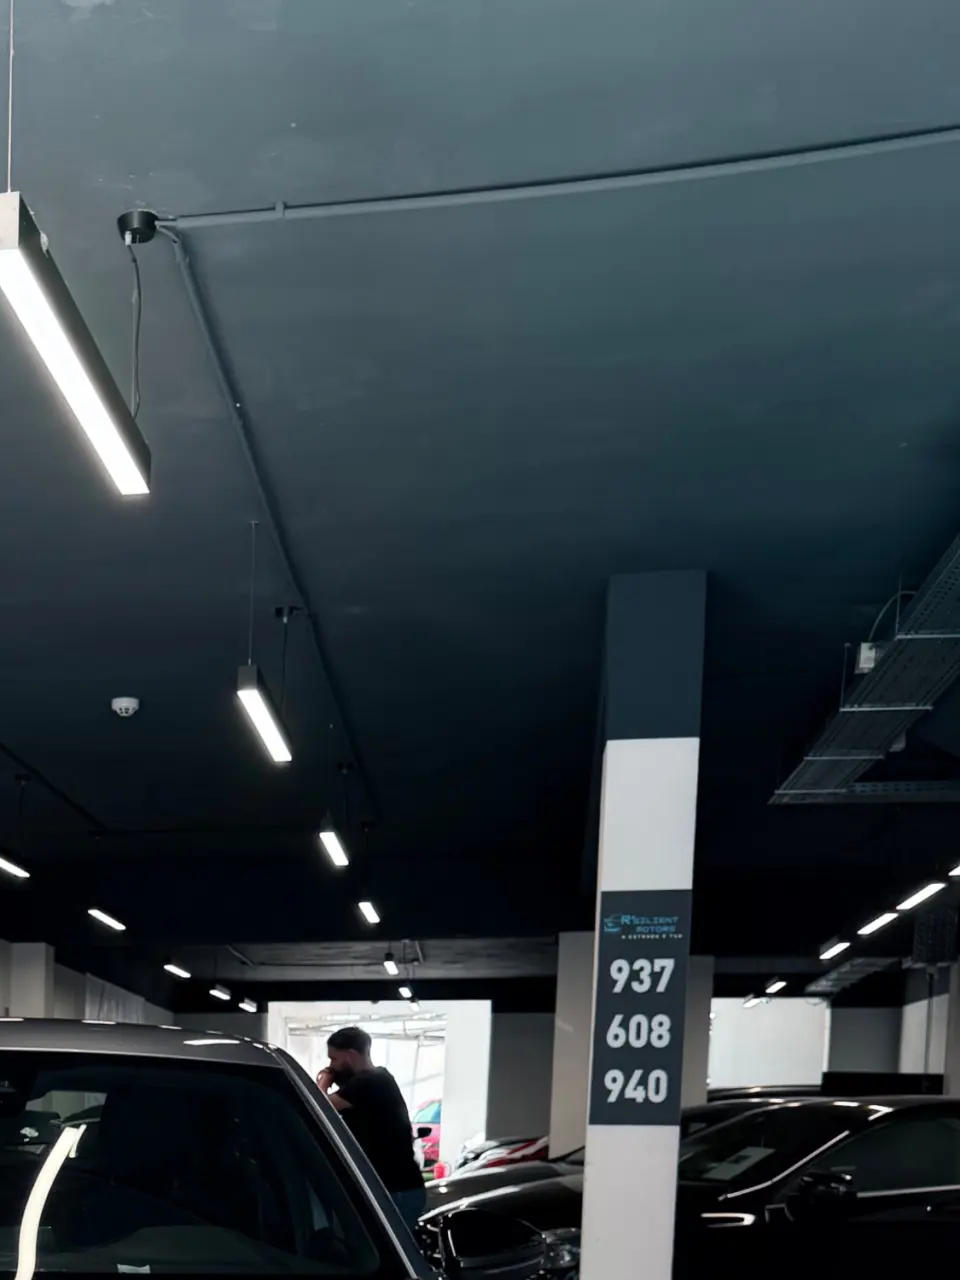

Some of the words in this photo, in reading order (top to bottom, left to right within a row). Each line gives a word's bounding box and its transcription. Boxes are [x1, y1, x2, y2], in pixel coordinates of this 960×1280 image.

[610, 958, 675, 993] 937
[606, 1014, 671, 1048] 608
[604, 1069, 668, 1103] 940
